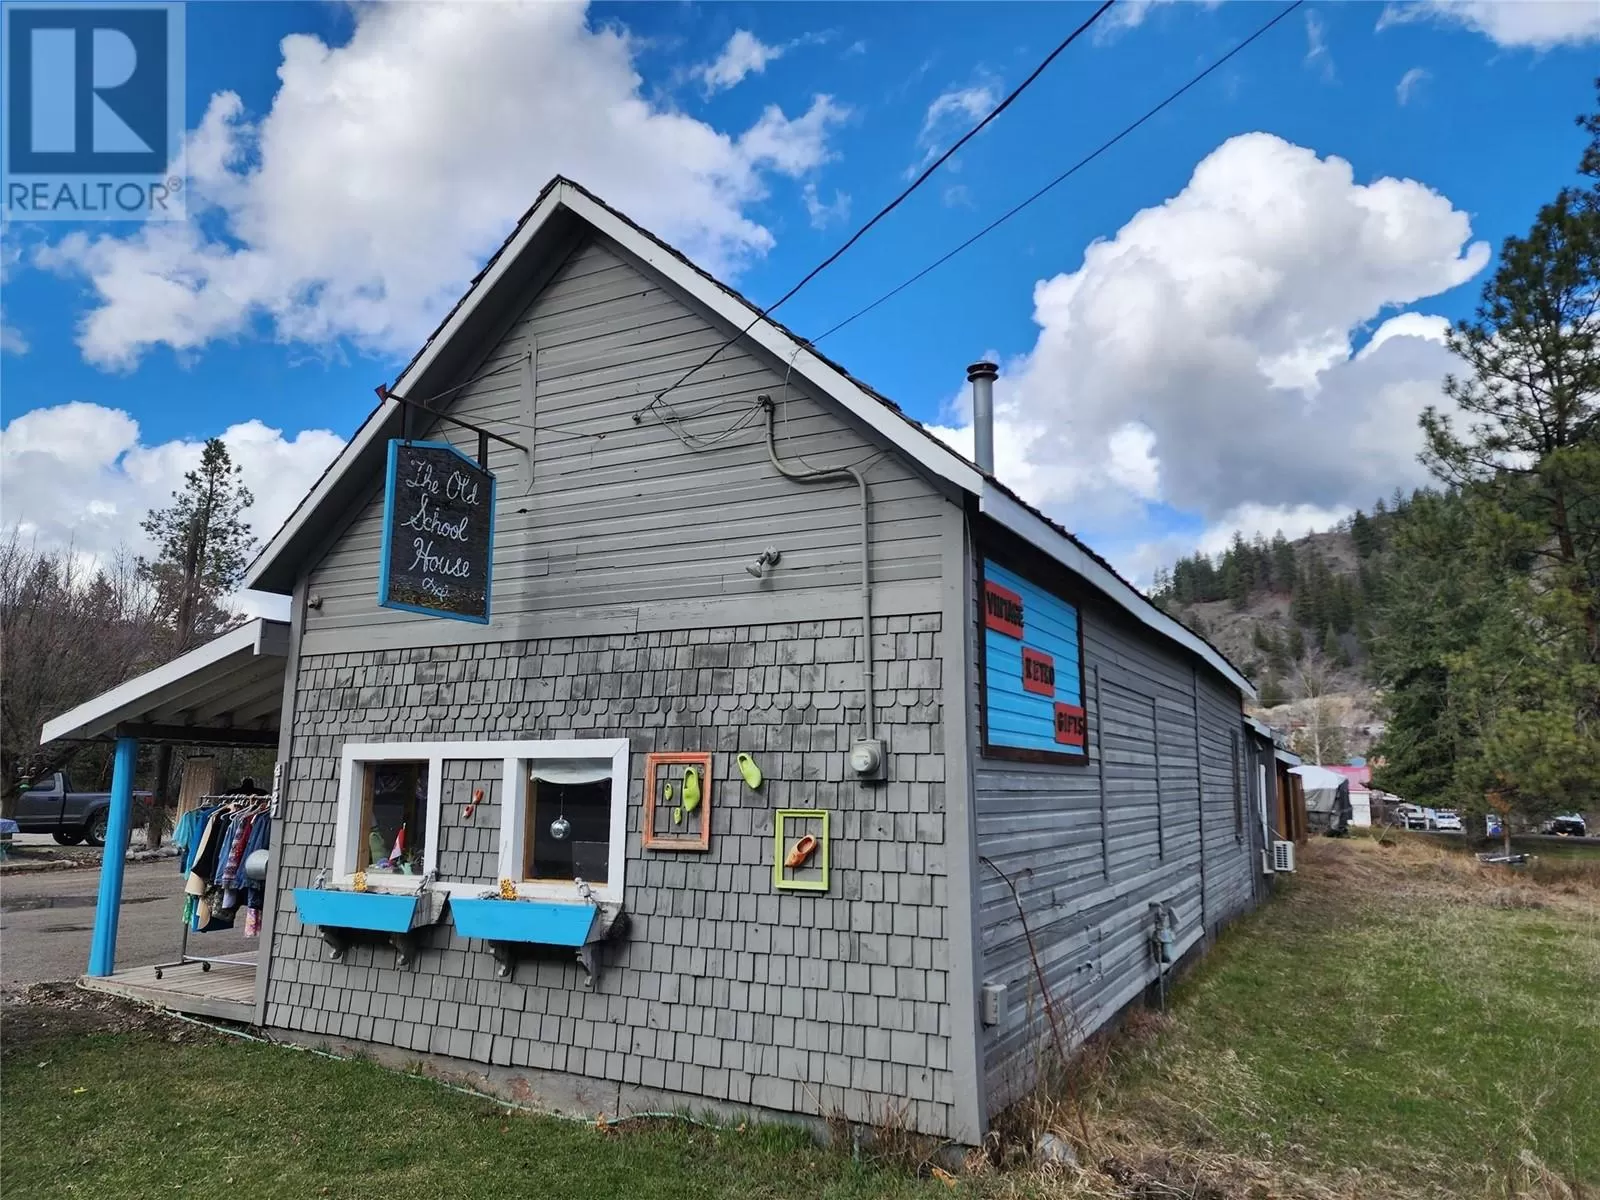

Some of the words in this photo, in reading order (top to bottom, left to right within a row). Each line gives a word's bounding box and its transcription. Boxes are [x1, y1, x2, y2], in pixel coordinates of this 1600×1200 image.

[405, 459, 440, 495] The
[446, 470, 480, 506] Old
[401, 493, 469, 542] School
[409, 537, 470, 578] House
[1057, 711, 1084, 736] GIFTS
